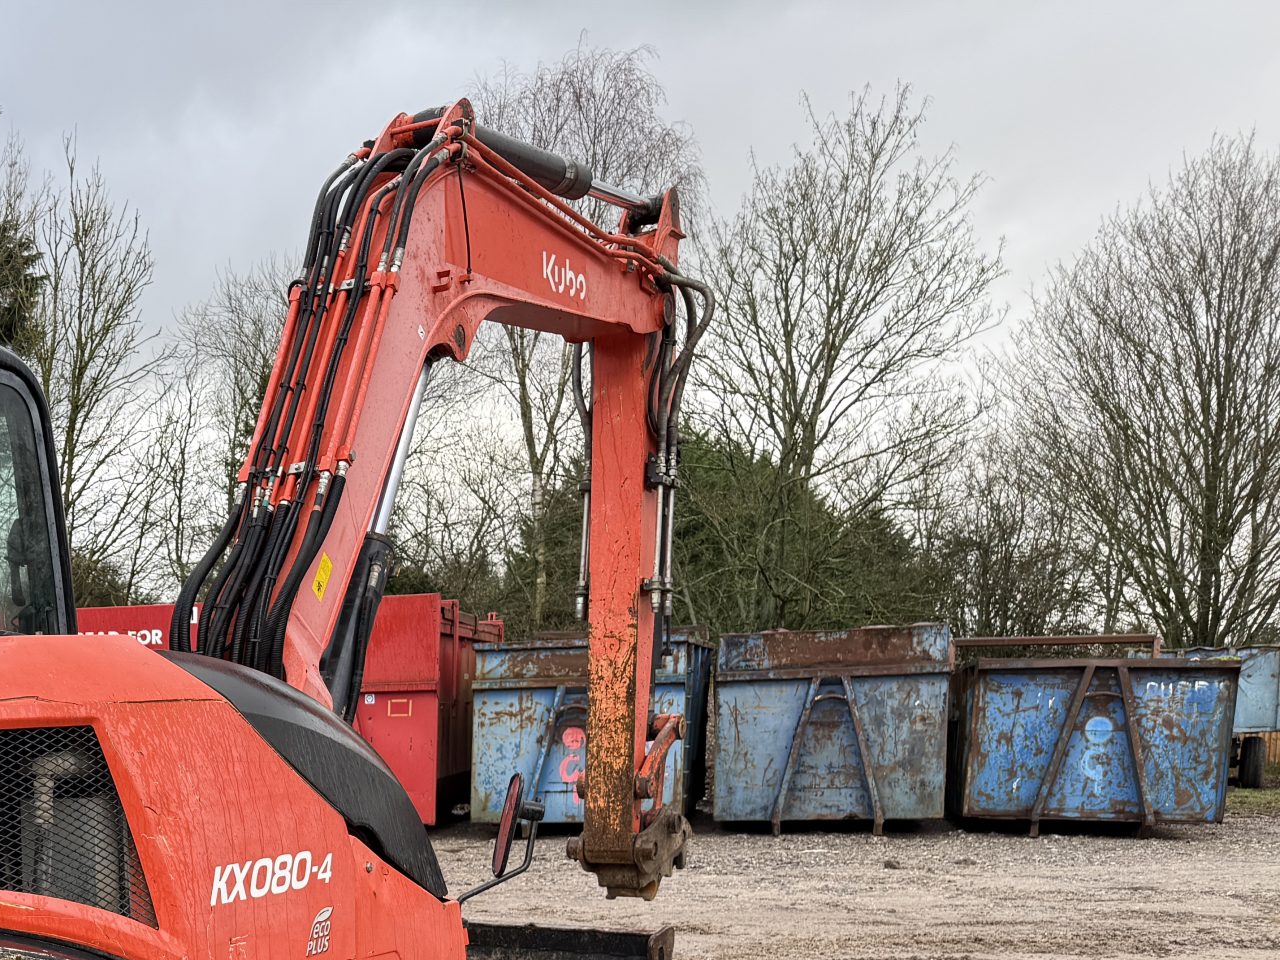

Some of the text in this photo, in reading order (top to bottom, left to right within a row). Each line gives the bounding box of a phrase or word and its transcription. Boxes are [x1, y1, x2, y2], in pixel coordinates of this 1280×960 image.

[210, 851, 333, 906] KX080-4
[313, 920, 331, 939] eco
[306, 936, 330, 957] PLUS
